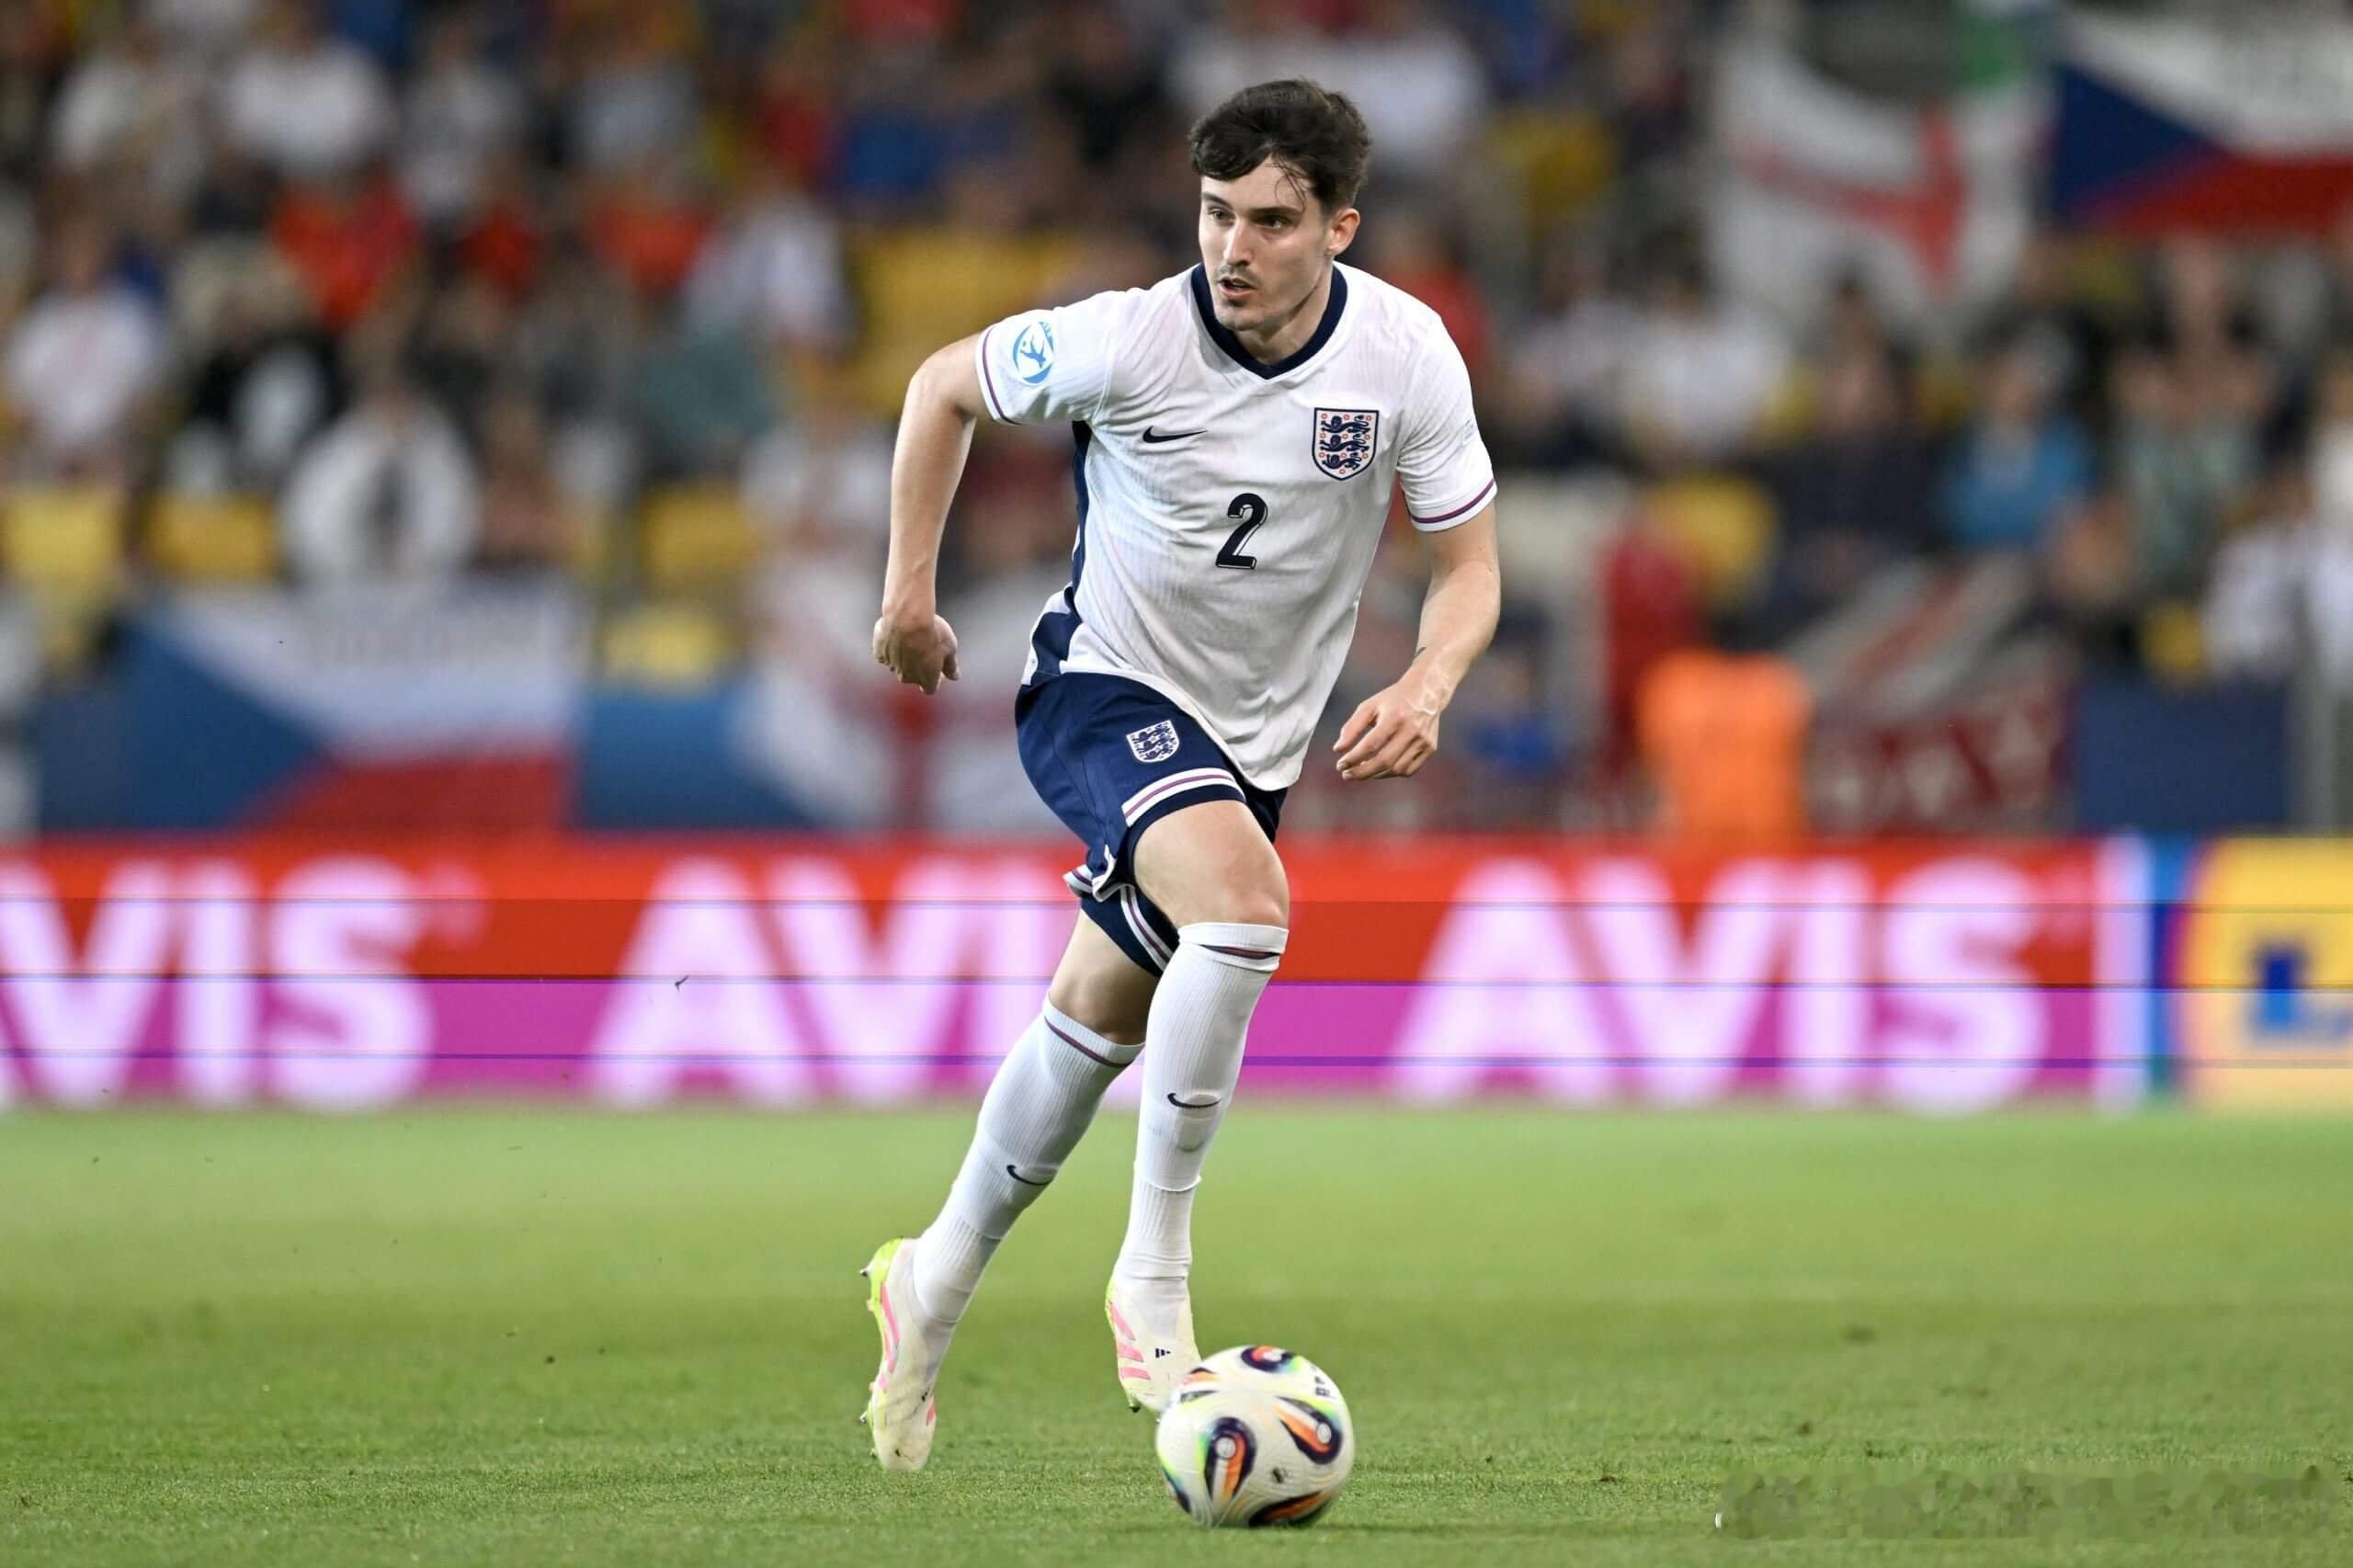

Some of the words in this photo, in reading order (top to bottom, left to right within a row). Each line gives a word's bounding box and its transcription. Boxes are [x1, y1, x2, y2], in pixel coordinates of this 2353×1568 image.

[1215, 492, 1268, 570] 2
[0, 855, 437, 1110] VIS
[590, 855, 1144, 1108] AVI
[1392, 855, 2046, 1112] AVIS
